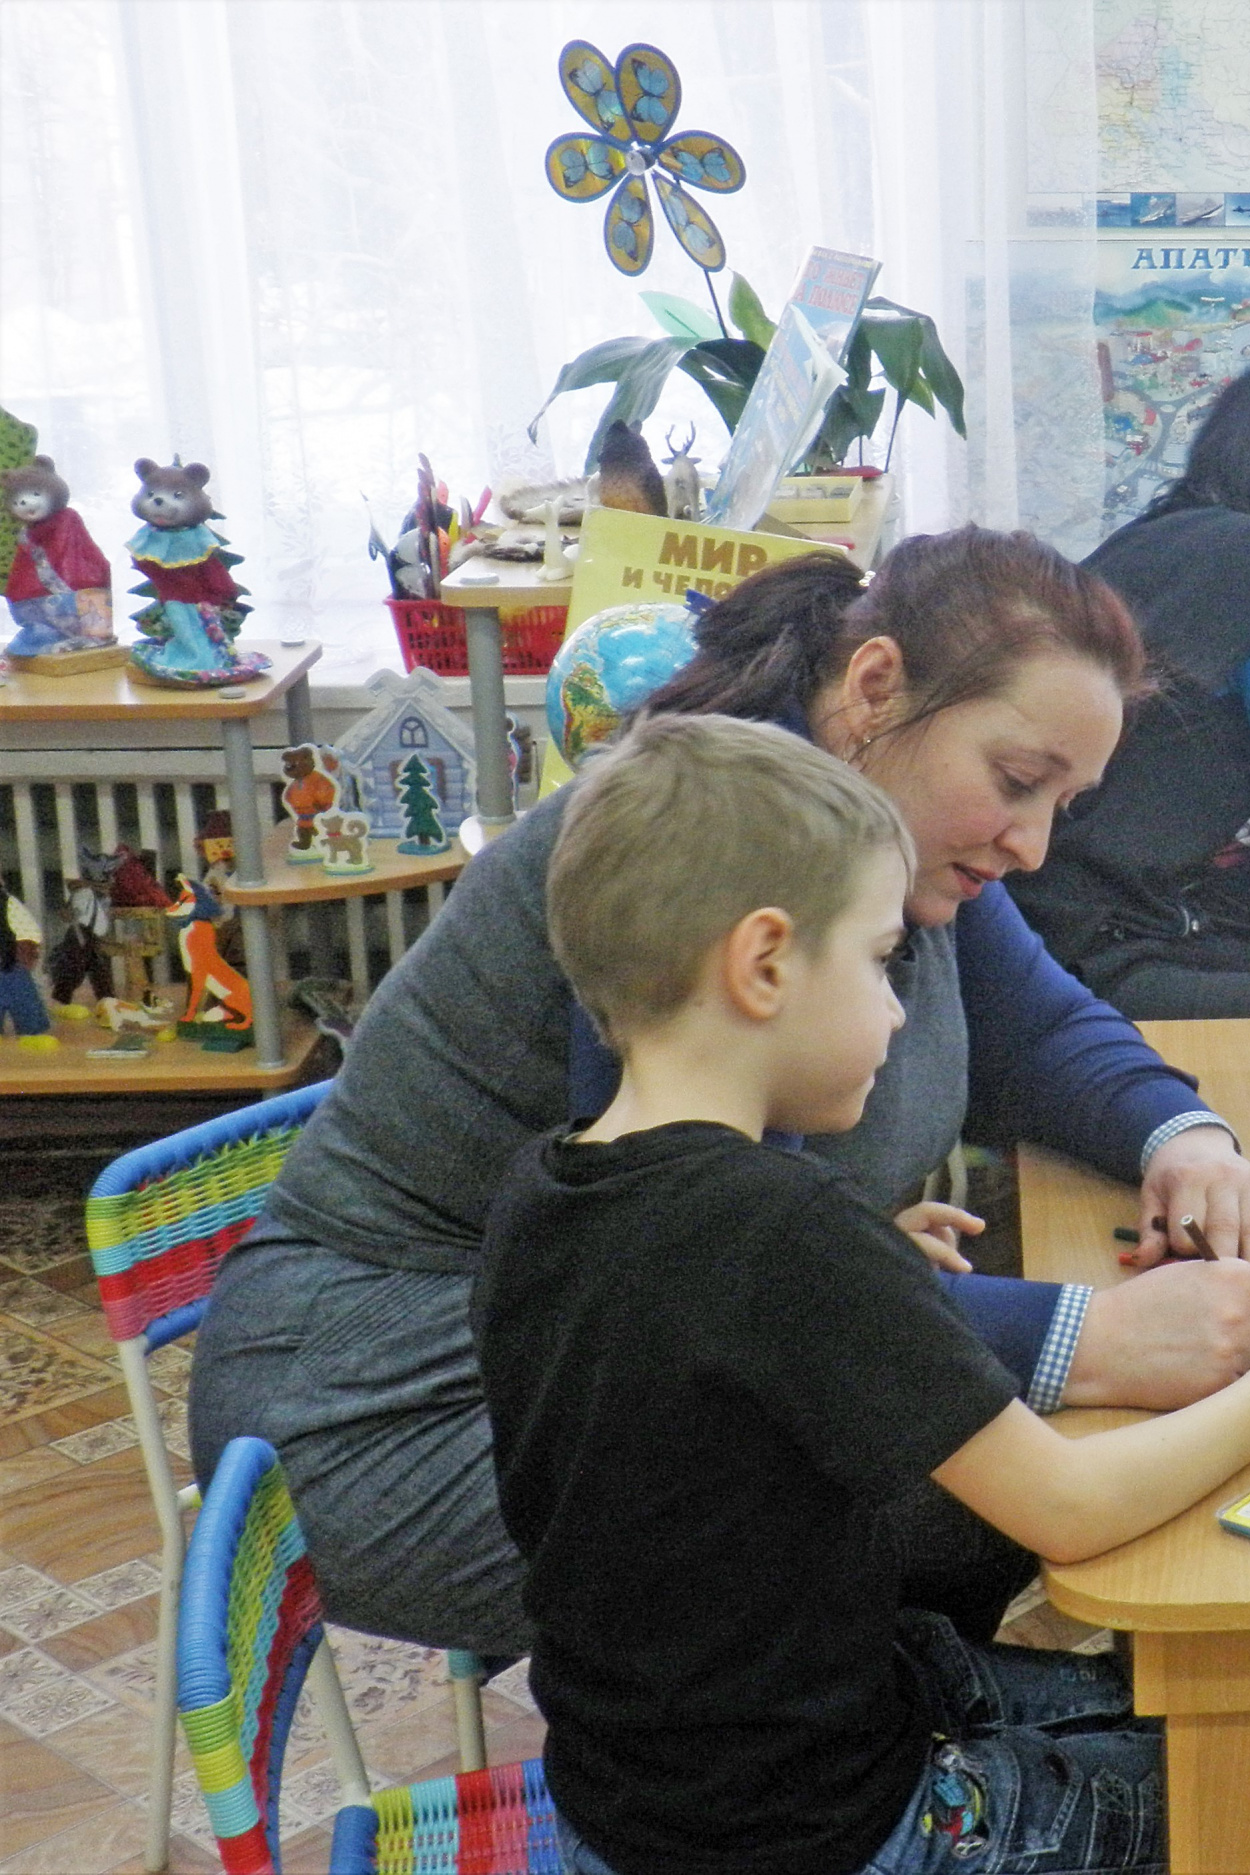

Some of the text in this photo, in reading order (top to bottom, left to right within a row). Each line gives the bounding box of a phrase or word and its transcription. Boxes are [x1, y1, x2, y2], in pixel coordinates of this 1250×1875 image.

[659, 531, 768, 577] МИР
[621, 566, 735, 599] И ЧЕЛО
